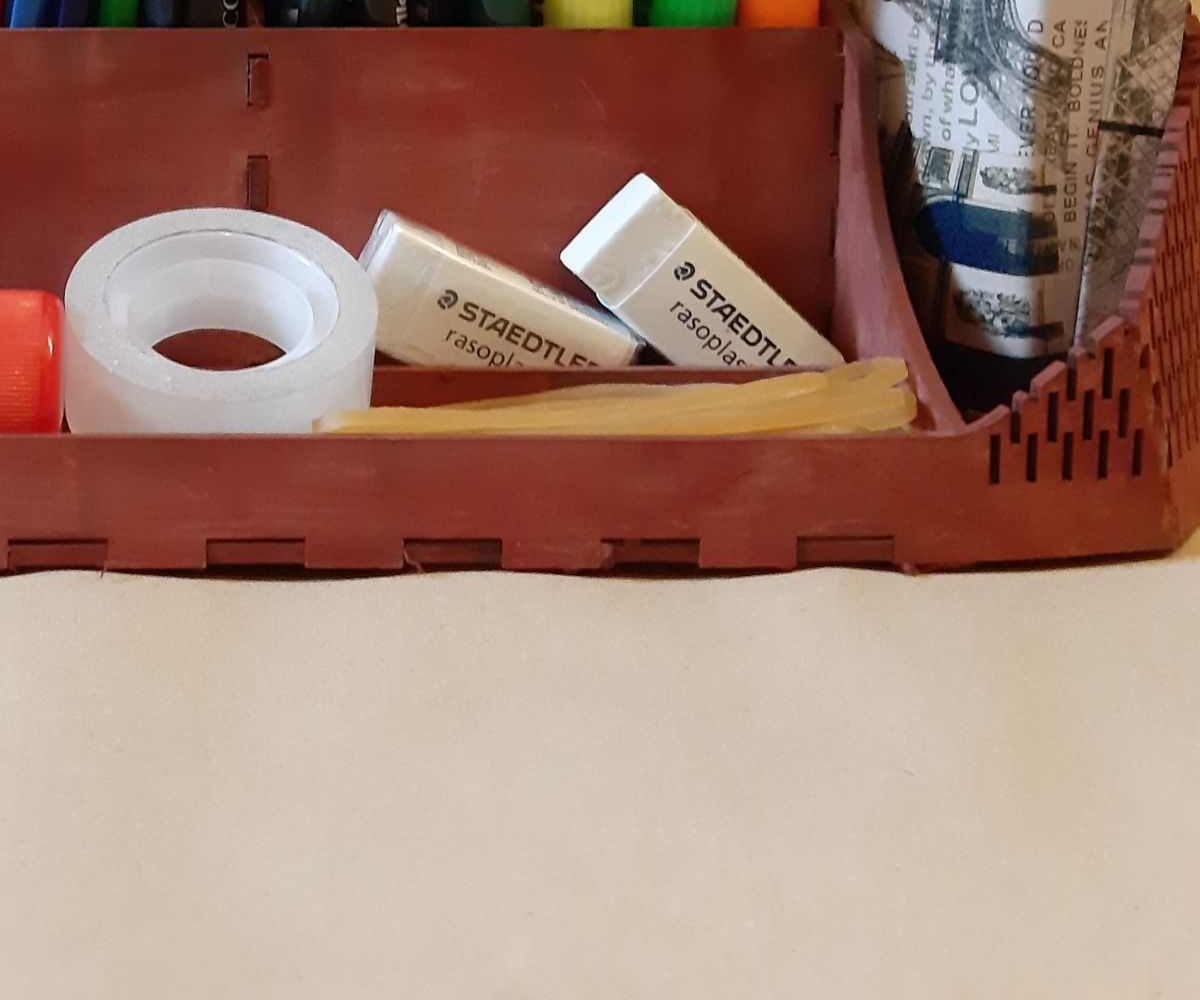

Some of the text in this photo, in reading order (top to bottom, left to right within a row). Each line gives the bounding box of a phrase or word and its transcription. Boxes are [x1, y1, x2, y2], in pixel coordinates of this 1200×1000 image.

[1063, 161, 1078, 223] BEGIN
[445, 327, 524, 368] rasopl
[457, 301, 601, 367] STAEDTLE
